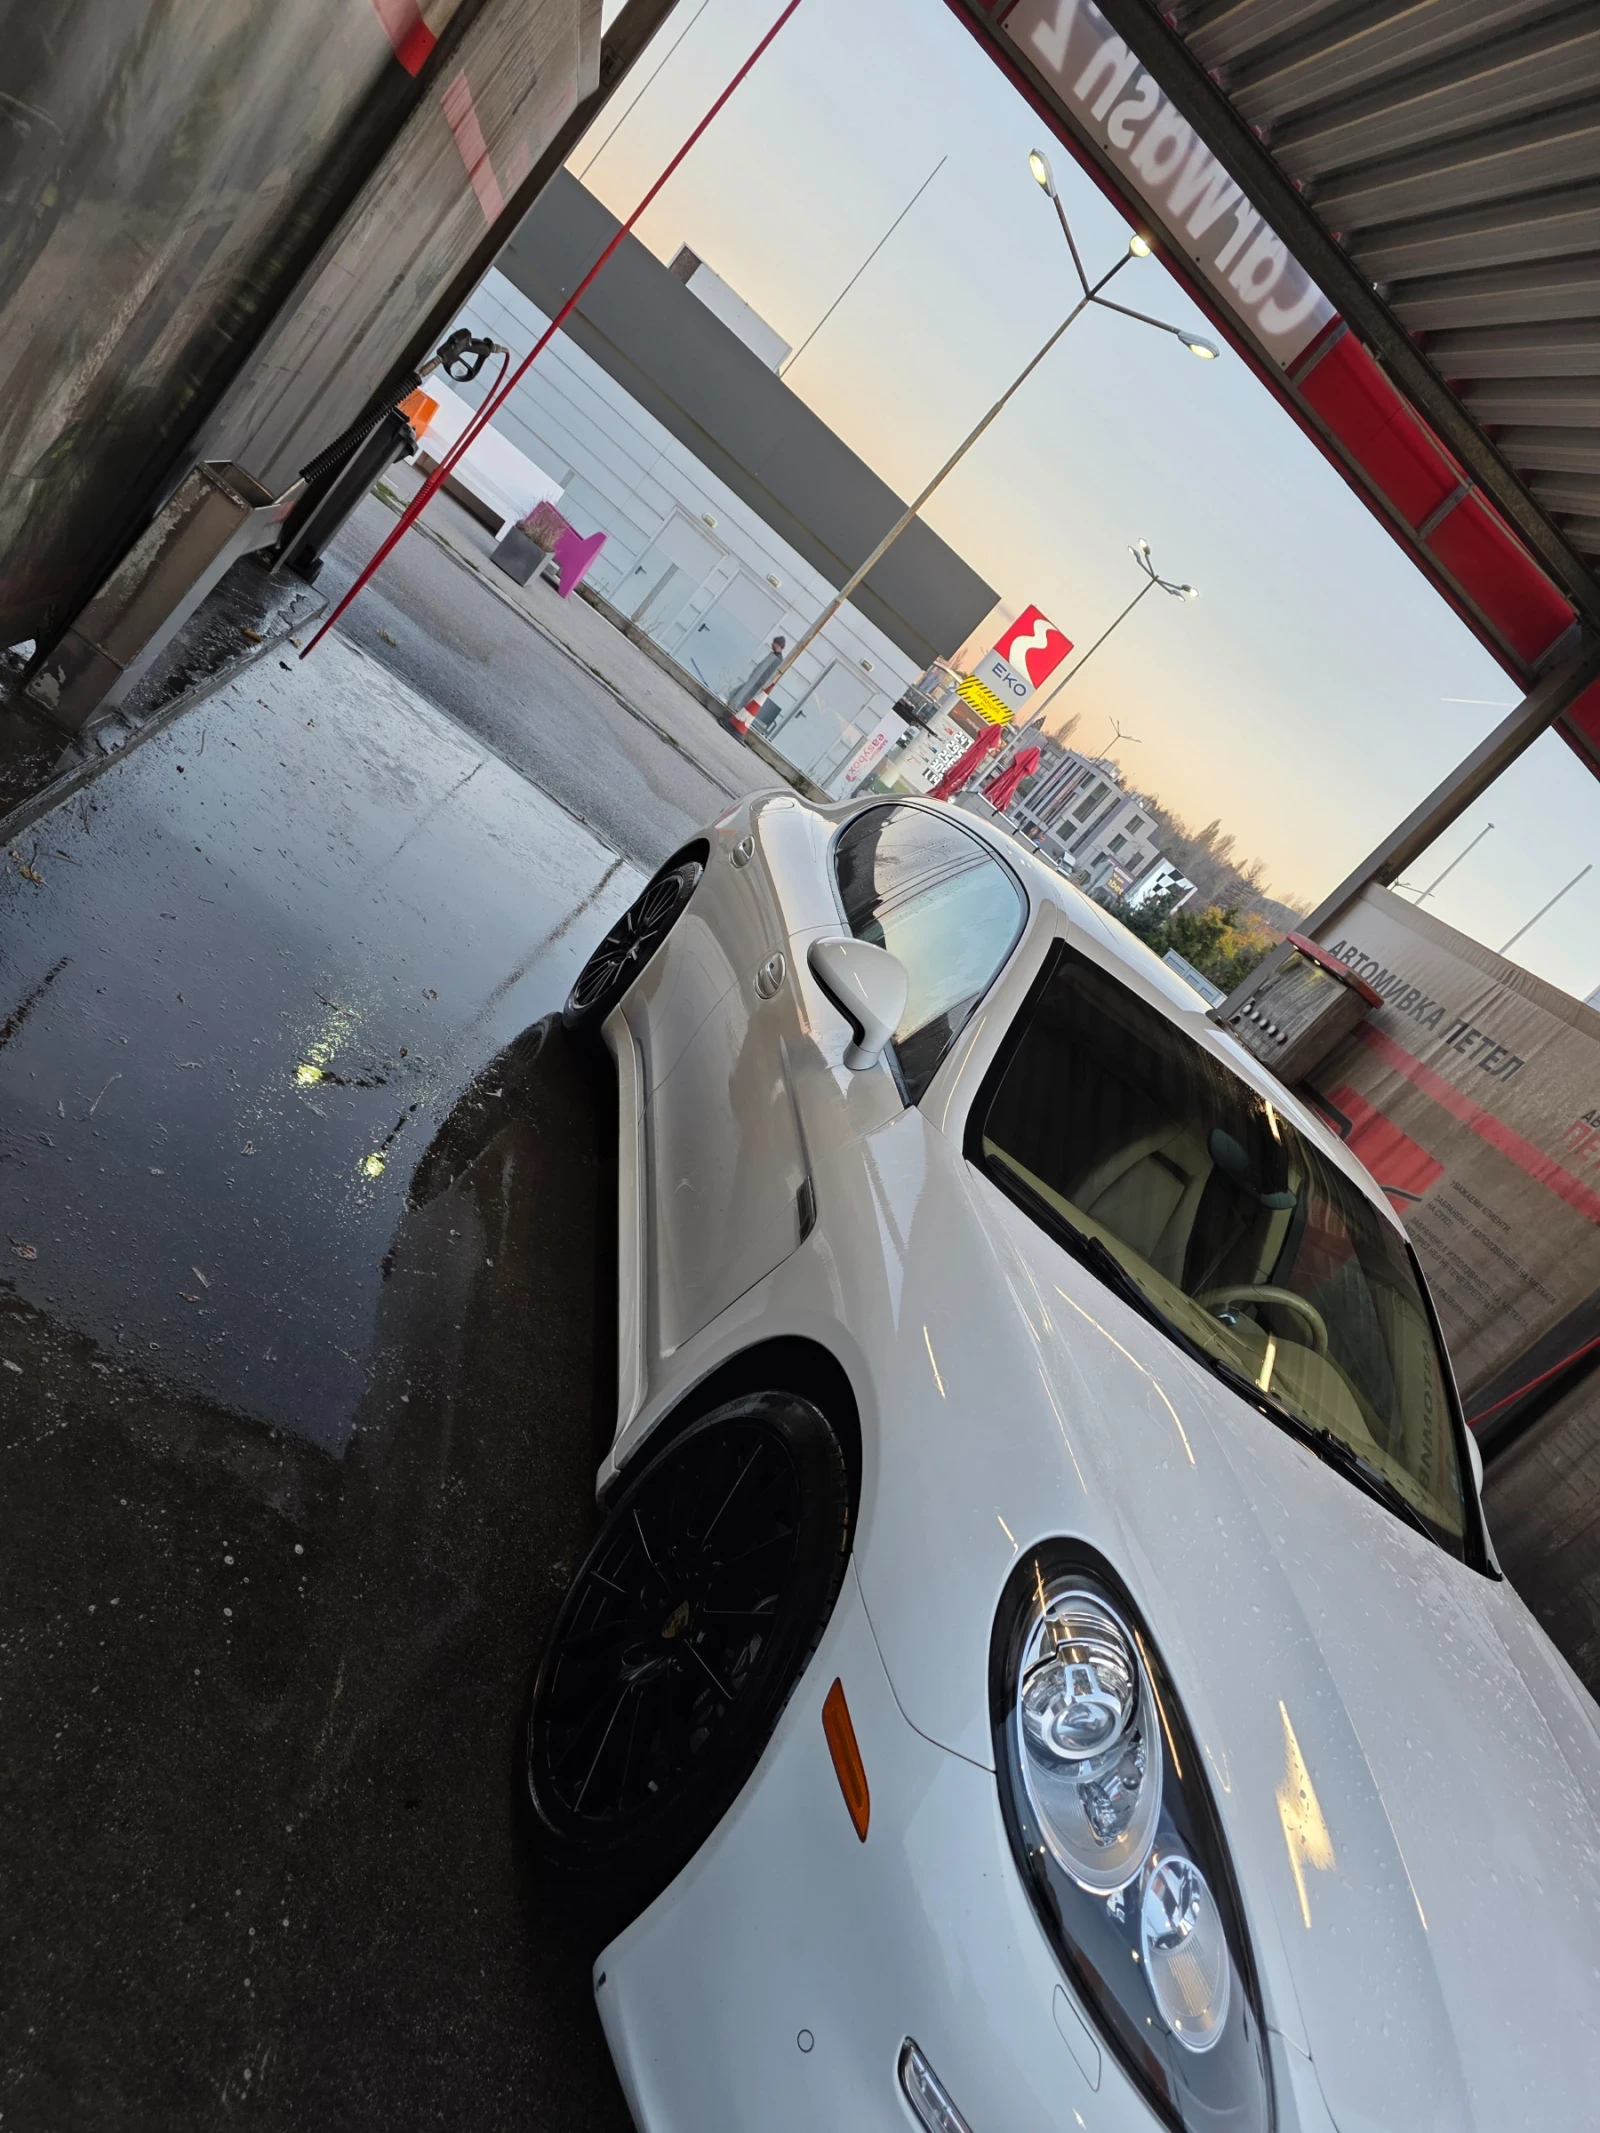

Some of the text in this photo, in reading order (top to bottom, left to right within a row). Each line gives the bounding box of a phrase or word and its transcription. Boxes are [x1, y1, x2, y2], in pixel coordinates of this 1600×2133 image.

[991, 662, 1028, 698] EKO
[848, 732, 885, 775] easybox
[1327, 938, 1526, 1084] АВТОМИВКА ПЕТЕЛ
[1426, 1203, 1453, 1228] НА СУХО!
[1449, 1180, 1483, 1211] УВАЖАЕМИ
[1410, 1217, 1444, 1250] ЗАБРАНЕНО
[1447, 1250, 1494, 1295] ИЗПОЛЗВАНЕТО
[1491, 1292, 1502, 1304] НА
[1413, 1234, 1430, 1251] ПРЕЗ
[1439, 1259, 1450, 1270] НЕ
[1447, 1266, 1465, 1284] ТЕЧЕ
[1434, 1194, 1468, 1227] ЗАБРАНЕНО
[1471, 1228, 1520, 1272] ИЗПОЛЗВАНЕТО
[1517, 1269, 1530, 1281] НА
